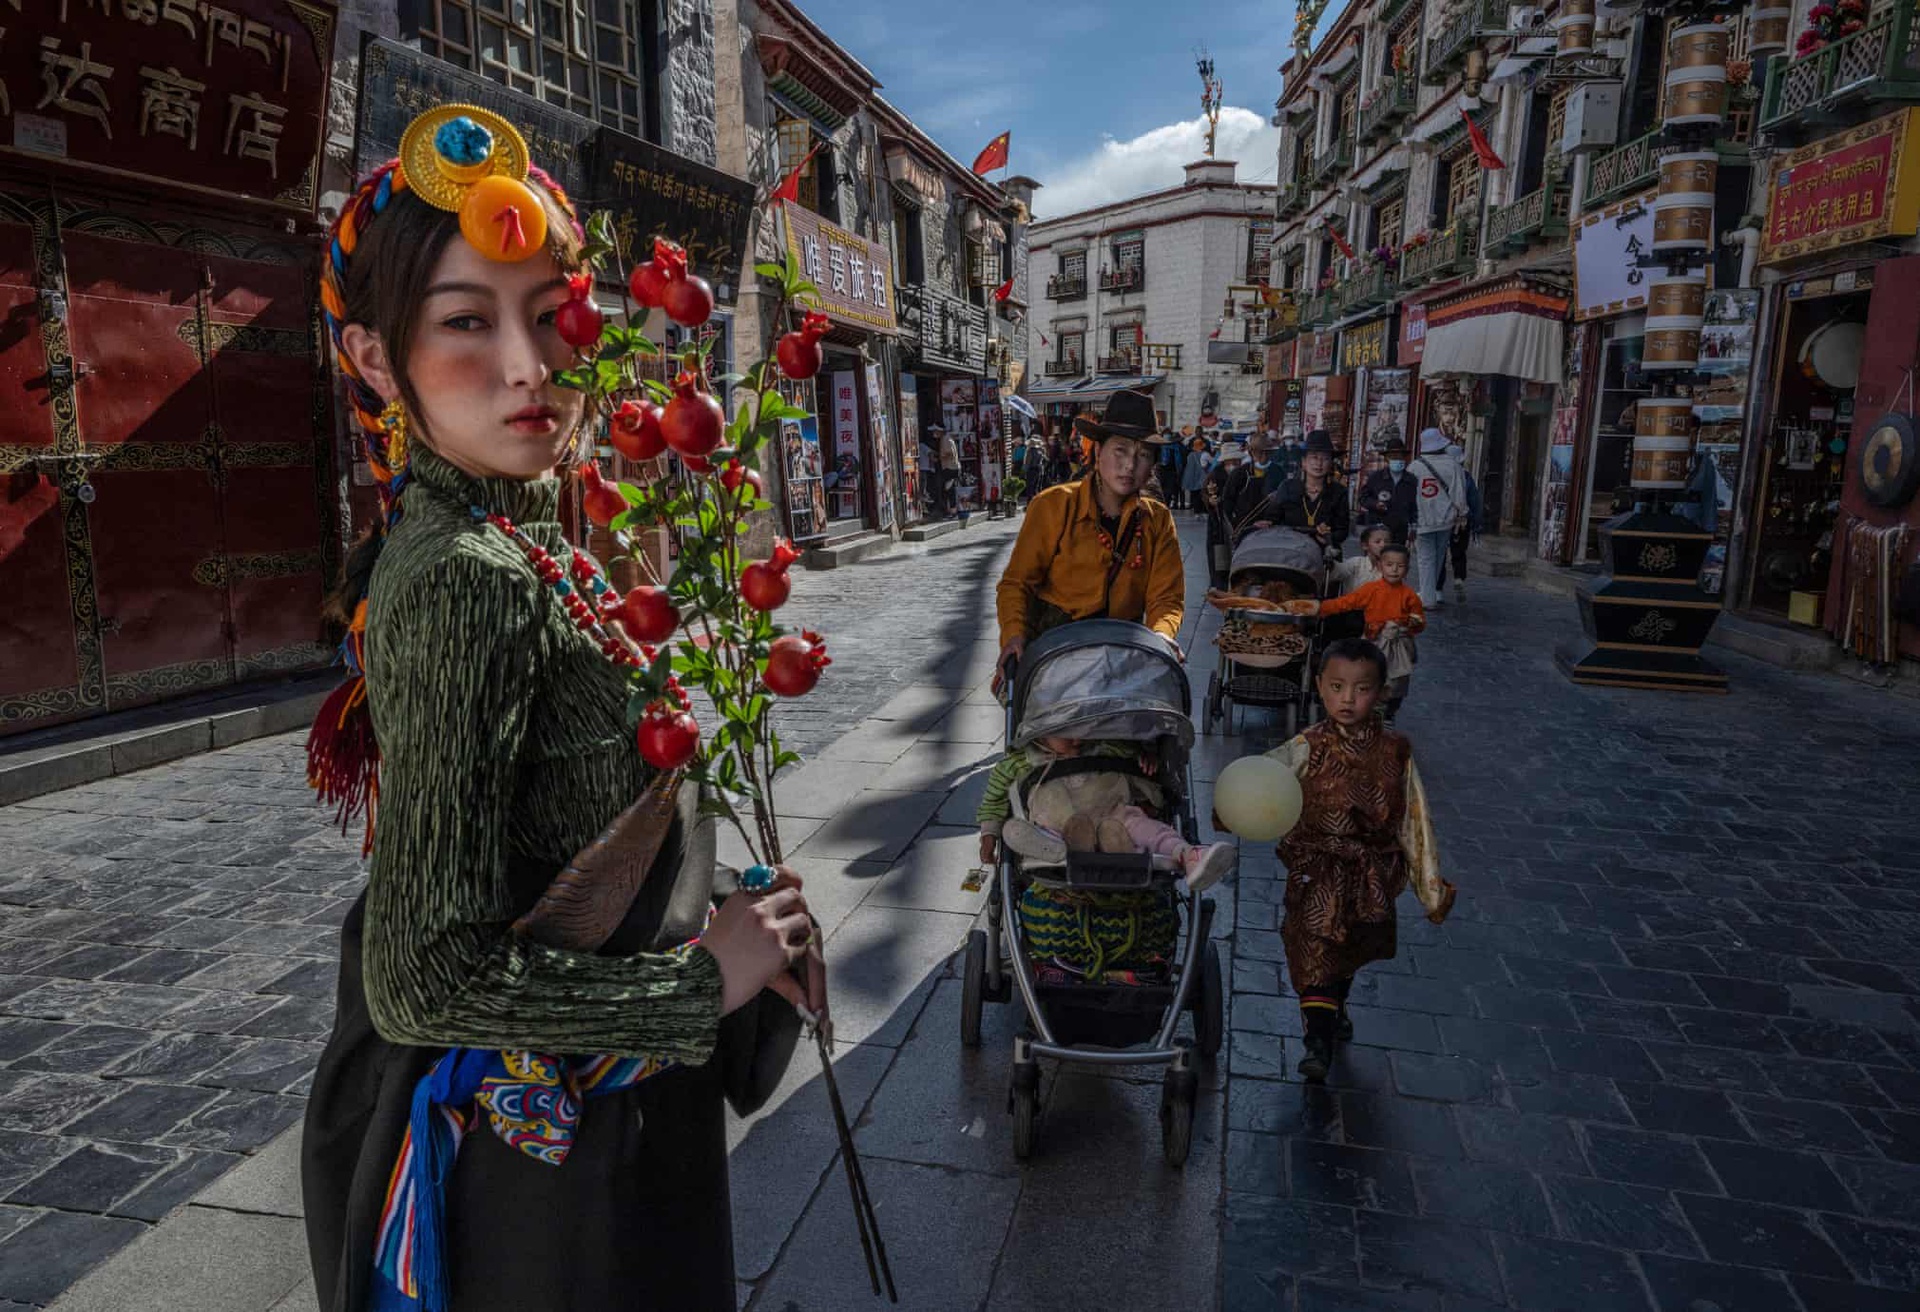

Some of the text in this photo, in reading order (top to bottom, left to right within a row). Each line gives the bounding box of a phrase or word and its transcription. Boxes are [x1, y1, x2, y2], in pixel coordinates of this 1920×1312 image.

[0, 27, 290, 180] 达商店
[803, 234, 887, 309] 唯爱旅拍
[839, 386, 855, 507] 唯美夜拍
[1421, 478, 1439, 498] 5
